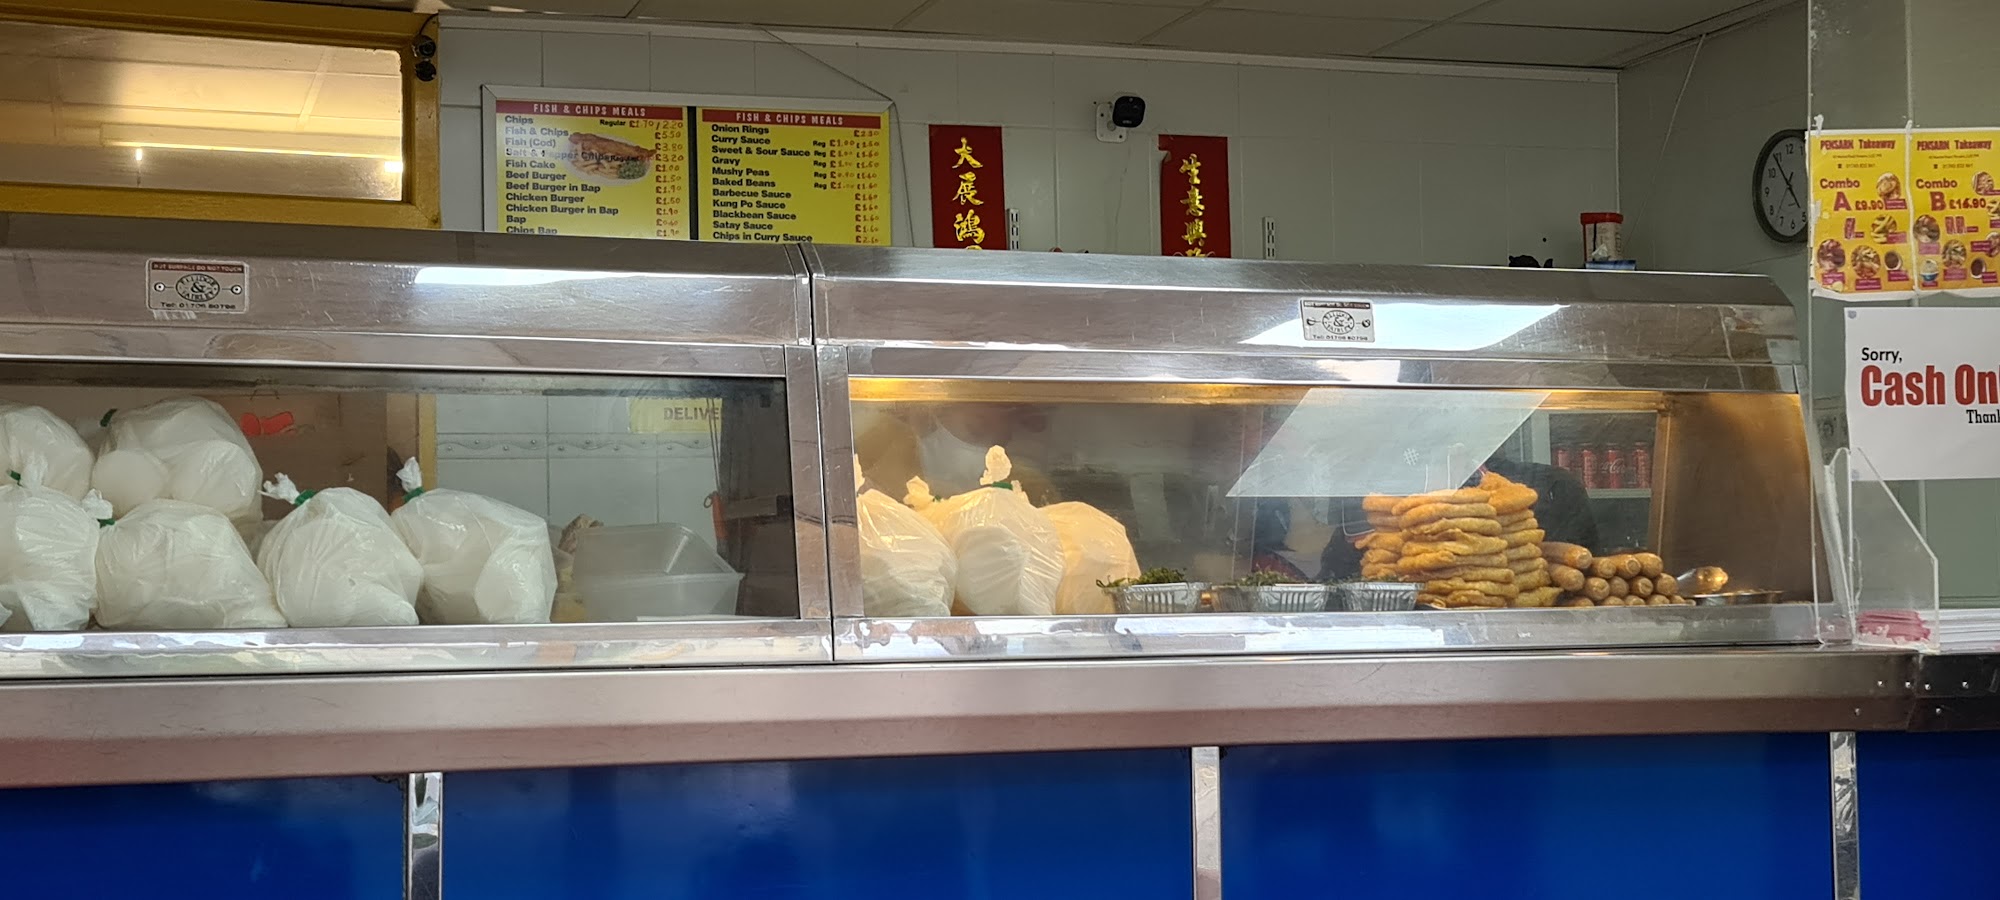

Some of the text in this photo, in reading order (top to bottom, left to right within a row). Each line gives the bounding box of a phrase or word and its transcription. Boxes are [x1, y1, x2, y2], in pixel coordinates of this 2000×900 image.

[534, 104, 646, 116] FISH & CHIPS MEALS
[505, 116, 534, 124] Chips
[736, 112, 843, 125] FISH & CHIPS MEALS
[505, 126, 526, 134] Fish
[540, 128, 568, 137] Chips
[712, 124, 740, 132] Onion
[742, 125, 769, 134] Rings
[505, 138, 526, 146] Fish
[530, 138, 556, 148] (Cod)
[712, 135, 738, 144] Curry
[741, 136, 770, 144] Sauce
[506, 148, 526, 156] Salt
[712, 146, 742, 154] Sweet
[756, 147, 778, 155] Sour
[781, 148, 810, 156] Sauce
[1786, 144, 1794, 154] 12
[506, 160, 526, 168] Fish
[712, 156, 740, 166] Gravy
[532, 172, 566, 180] Burger
[712, 167, 743, 176] Mushy
[746, 168, 770, 176] Peas
[814, 172, 826, 180] Reg
[1768, 168, 1776, 178] 10
[506, 182, 529, 190] Beef
[532, 183, 566, 192] Burger
[582, 184, 600, 193] Bap
[712, 178, 742, 186] Baked
[746, 179, 776, 188] Beans
[1820, 178, 1860, 189] Combo
[1916, 178, 1957, 188] Combo
[712, 188, 758, 198] Barbecue
[762, 190, 792, 198] Sauce
[952, 137, 985, 250] 大展鴻
[1764, 187, 1770, 196] 9
[506, 193, 548, 202] Chicken
[550, 194, 584, 203] Burger
[1834, 191, 1852, 211] A
[1930, 192, 1946, 211] B
[712, 199, 738, 208] Kung
[756, 200, 786, 208] Sauce
[506, 204, 548, 212] Chicken
[551, 205, 584, 214] Burger
[600, 206, 618, 215] Bap
[1770, 206, 1774, 215] 8
[506, 215, 526, 224] Bap
[713, 210, 764, 218] Blackbean
[766, 212, 796, 220] Sauce
[1802, 212, 1806, 222] 5
[713, 220, 740, 230] Satay
[743, 222, 773, 230] Sauce
[1780, 216, 1784, 226] 7
[1790, 220, 1796, 230] 6
[713, 232, 740, 240] Chips
[754, 232, 780, 242] Curry
[783, 234, 812, 242] Sauce
[191, 282, 206, 293] &
[1333, 317, 1344, 327] &
[1862, 347, 1902, 363] Sorry,
[1861, 364, 2000, 406] Cash On
